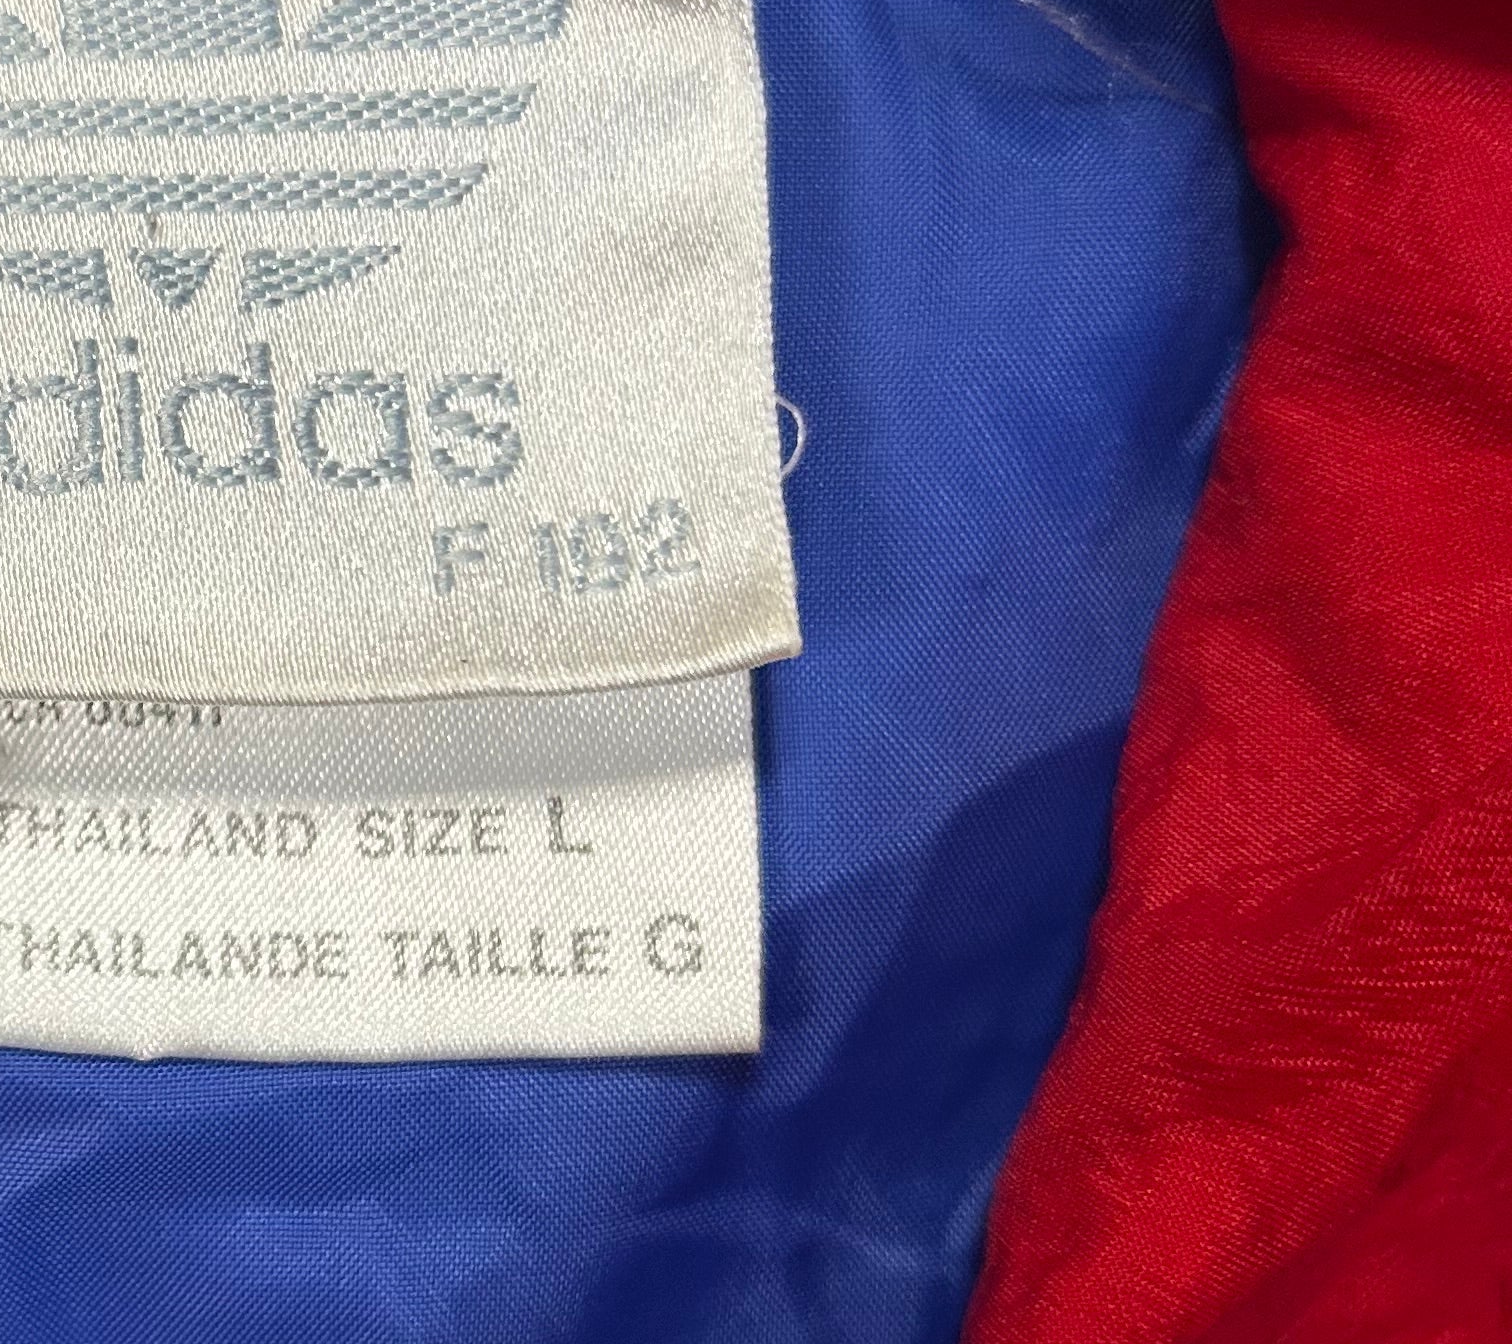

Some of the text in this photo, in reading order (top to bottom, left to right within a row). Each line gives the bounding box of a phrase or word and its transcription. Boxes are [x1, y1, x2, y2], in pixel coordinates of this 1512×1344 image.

[435, 497, 700, 594] F 192
[356, 807, 508, 857] SIZE
[546, 795, 592, 855] L
[382, 925, 611, 978] TAILLE
[644, 912, 704, 977] G
